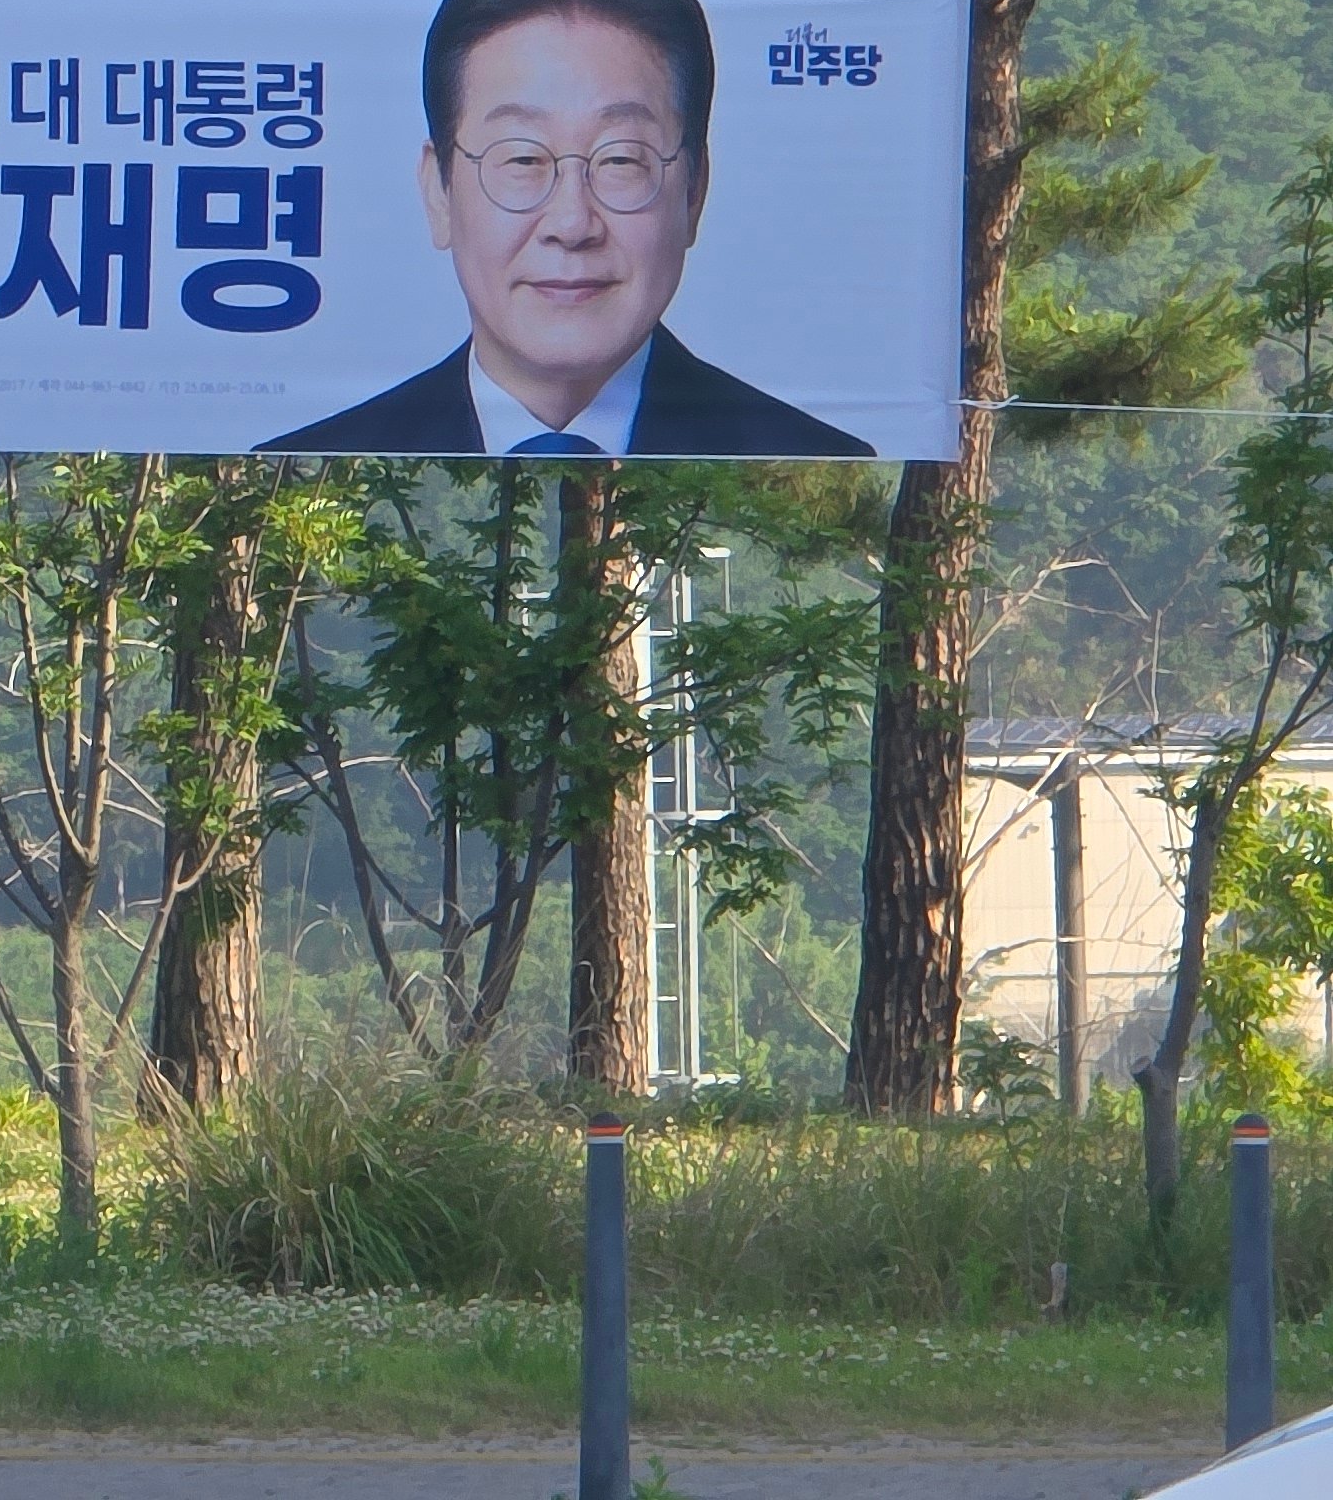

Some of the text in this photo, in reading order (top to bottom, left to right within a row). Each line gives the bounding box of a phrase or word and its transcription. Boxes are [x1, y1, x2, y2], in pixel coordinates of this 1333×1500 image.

[784, 21, 829, 47] 더불어
[768, 43, 883, 87] 민주당
[105, 59, 324, 149] 대통령
